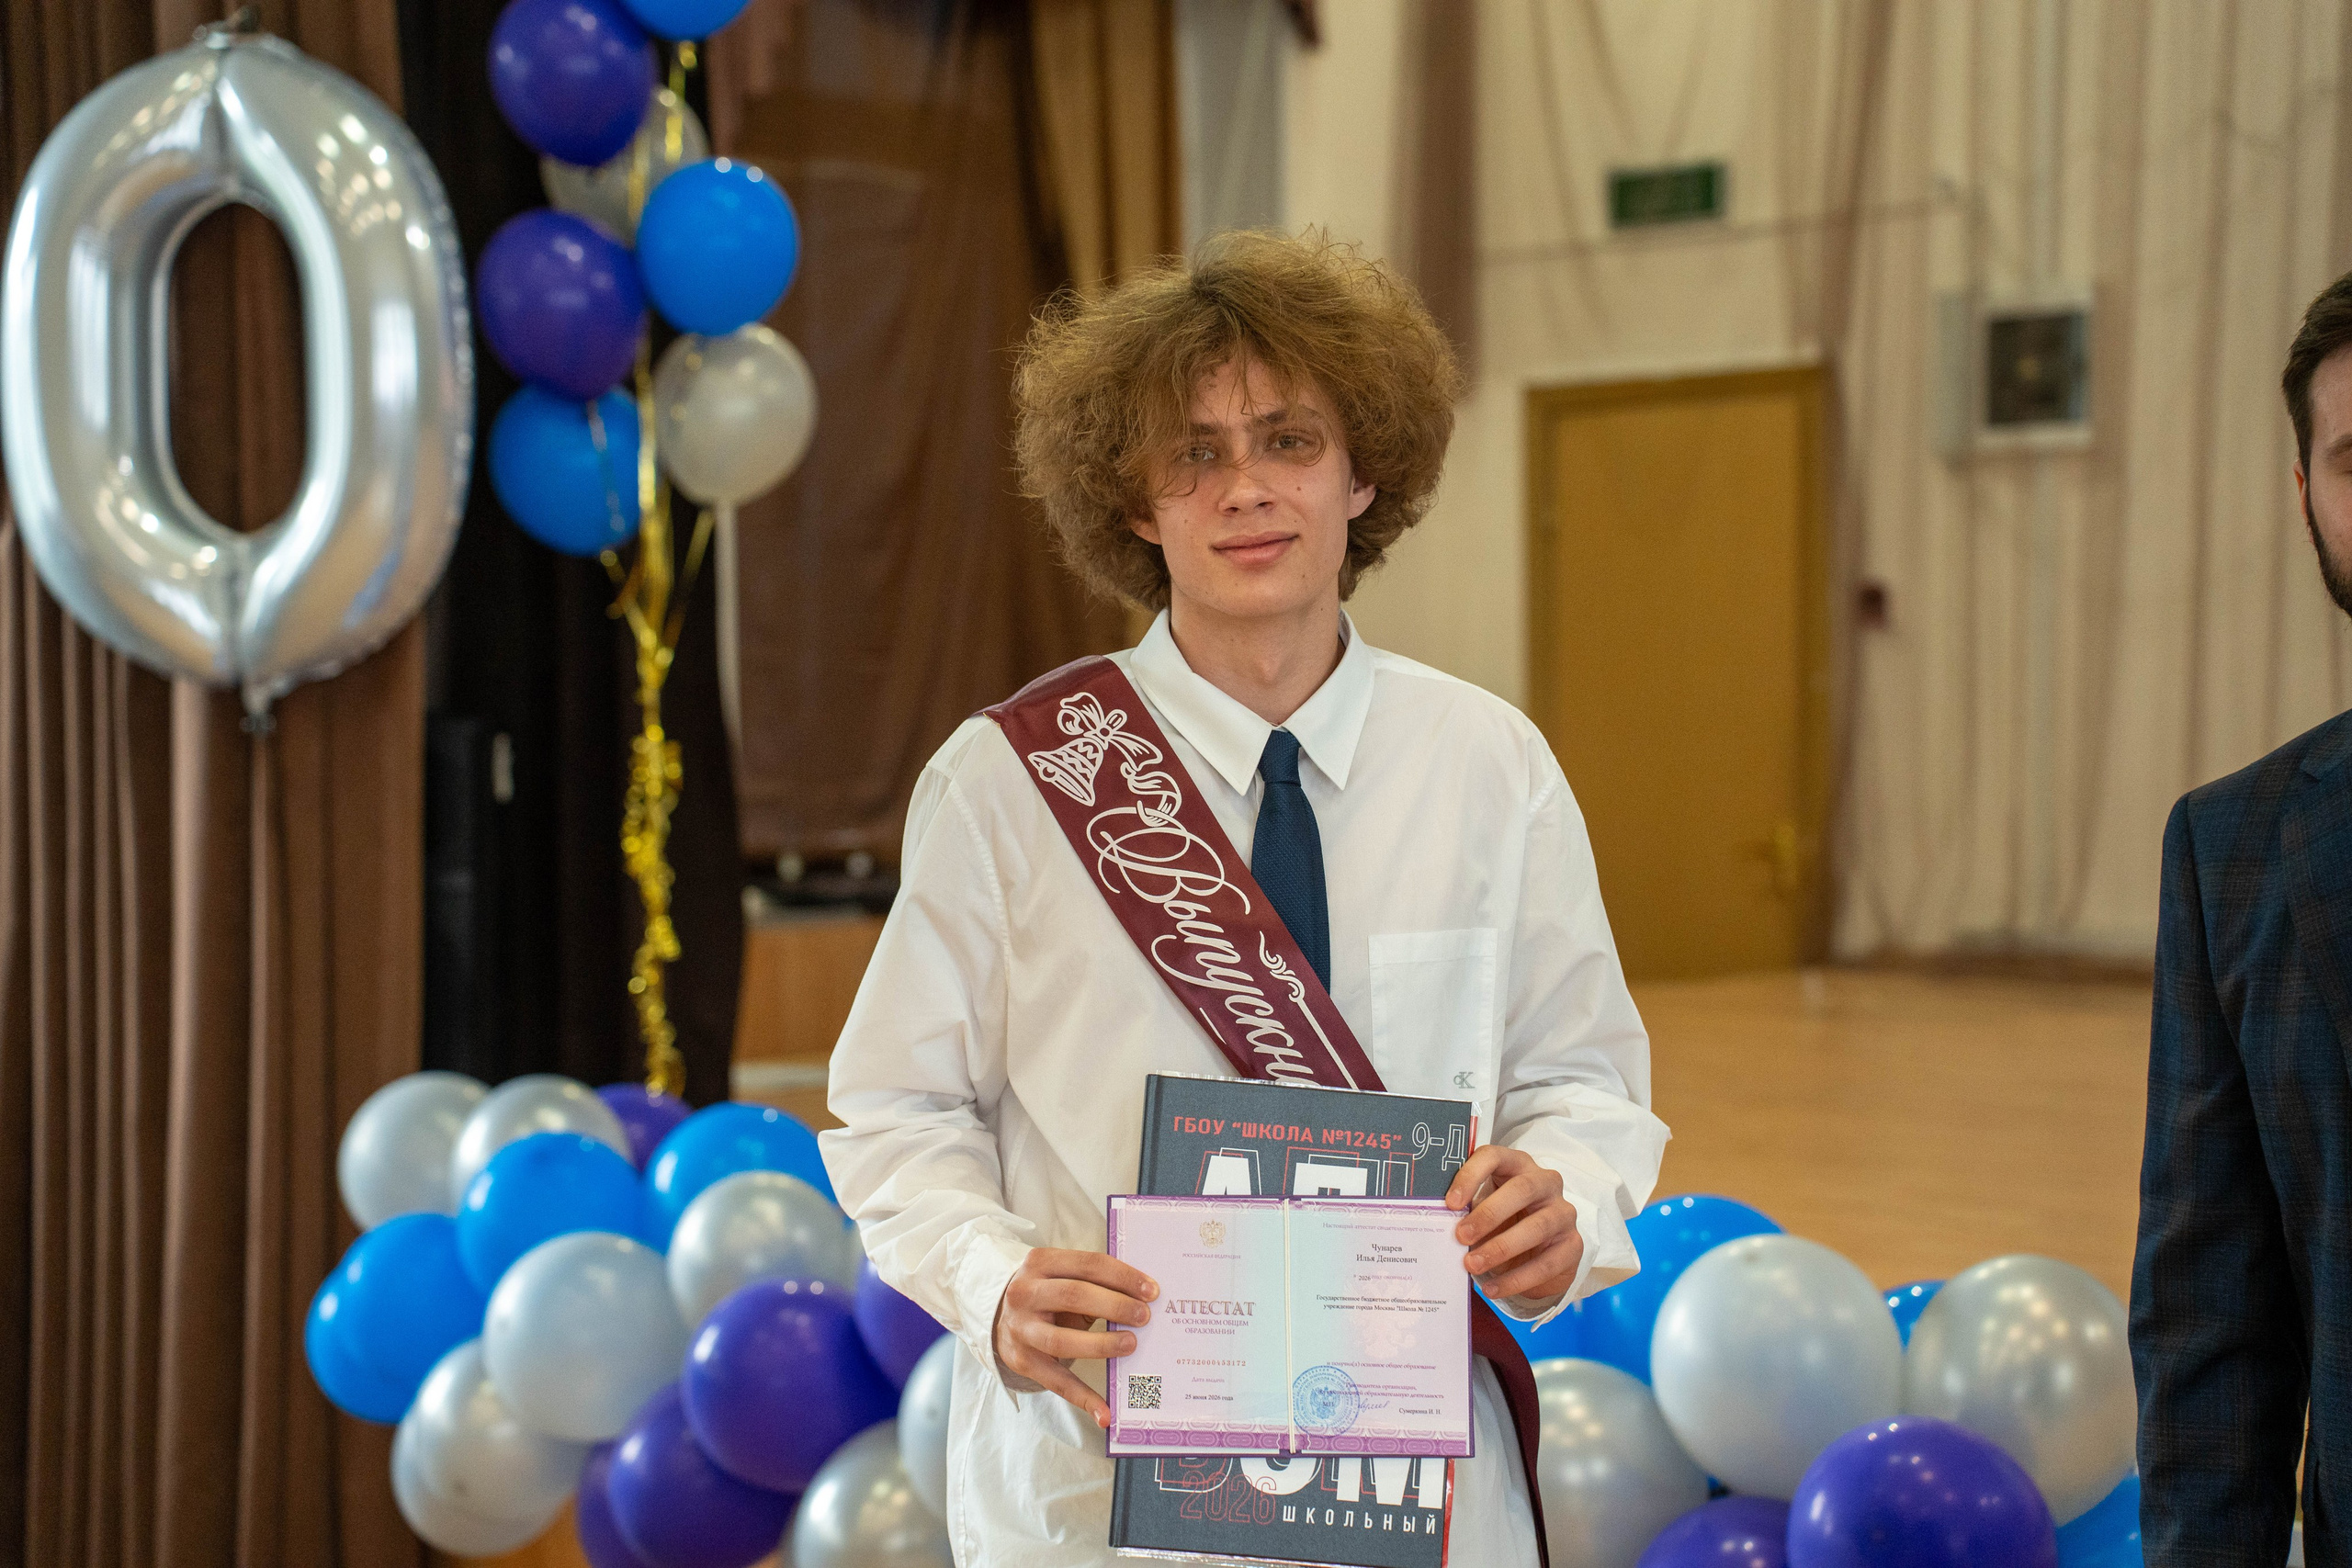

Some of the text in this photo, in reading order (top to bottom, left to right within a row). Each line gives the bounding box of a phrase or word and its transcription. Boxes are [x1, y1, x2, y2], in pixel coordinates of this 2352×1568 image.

[1173, 1115, 1225, 1135] ГБОУ
[1412, 1122, 1466, 1171] 9-Д
[1322, 1222, 1354, 1230] Настоящий
[1371, 1243, 1403, 1253] Чунарев
[1356, 1254, 1418, 1264] Илья Денисович
[1164, 1299, 1256, 1316] АТТЕСТАТ
[1390, 1297, 1447, 1305] общеобразовательное
[1181, 1470, 1276, 1526] 2026
[1283, 1505, 1436, 1535] ШКОЛЬНЫЙ
